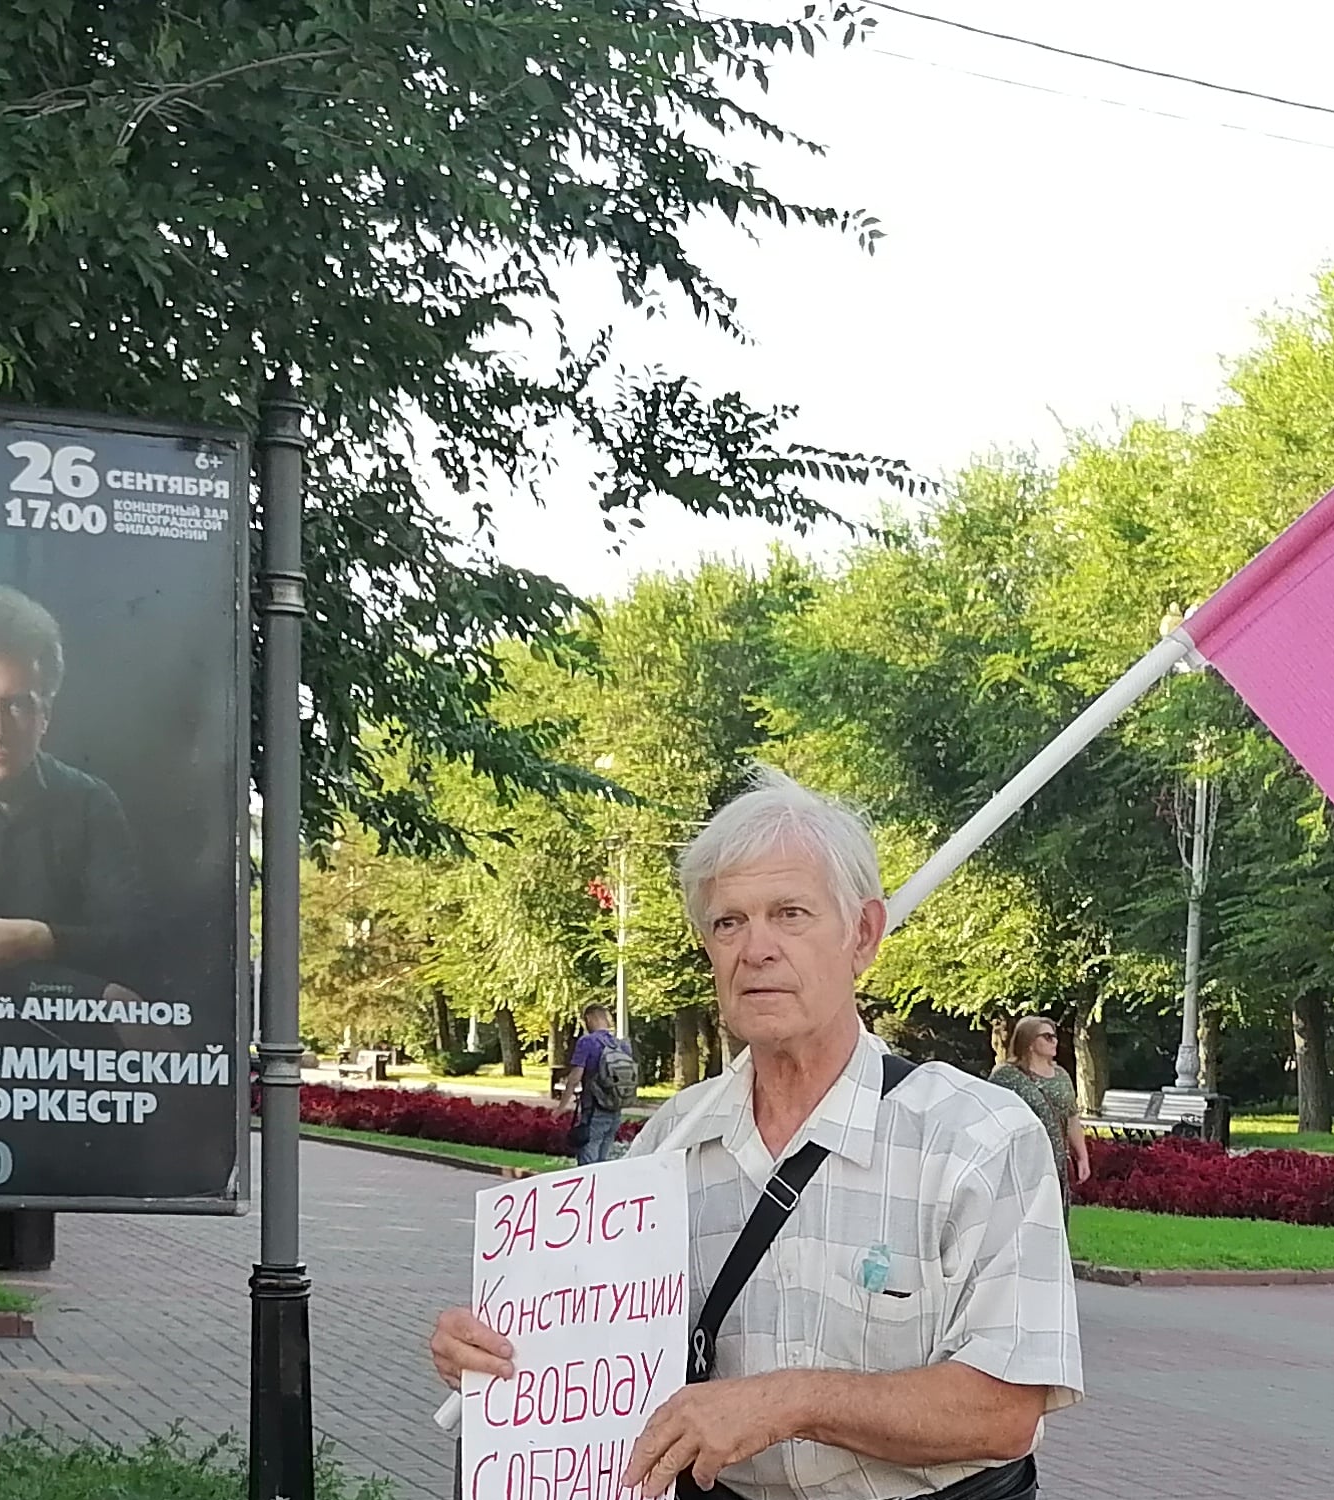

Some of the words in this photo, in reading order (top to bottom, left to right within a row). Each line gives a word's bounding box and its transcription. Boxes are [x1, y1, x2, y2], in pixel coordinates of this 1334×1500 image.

[6, 440, 100, 499] 26
[106, 470, 230, 499] СЕНТЯБРЯ
[195, 452, 224, 470] 6+
[4, 497, 106, 535] 17:00
[113, 499, 201, 518] КОНЦЕРТНЫЙ
[203, 506, 229, 521] ЗАЛ
[113, 511, 223, 531] ВОЛГОГРАДСКОЙ
[113, 522, 208, 541] ФИЛАРМОНИИ
[20, 996, 193, 1026] АНИХАНОВ
[481, 1187, 537, 1261] ЗА
[545, 1174, 597, 1249] 31
